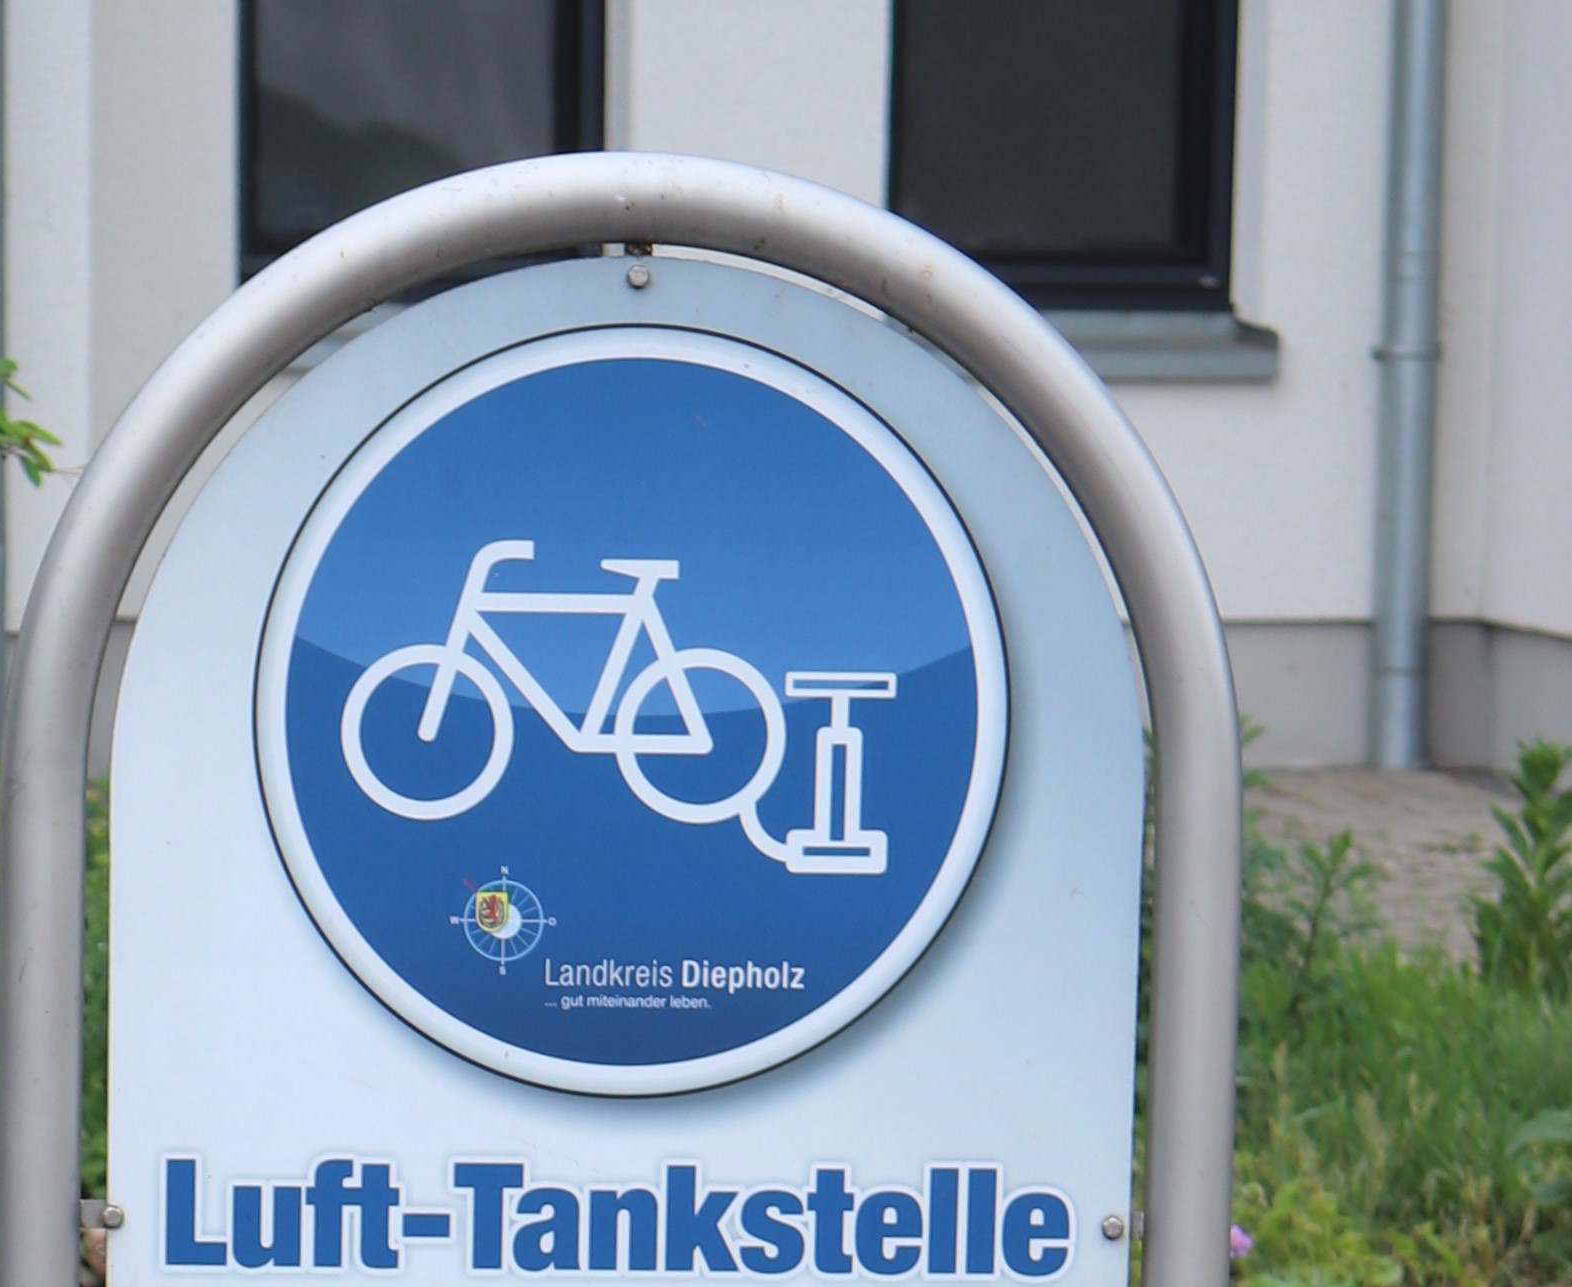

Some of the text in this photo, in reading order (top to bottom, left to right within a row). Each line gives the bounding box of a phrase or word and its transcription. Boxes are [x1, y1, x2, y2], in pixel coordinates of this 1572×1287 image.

[500, 865, 509, 875] N
[499, 965, 507, 975] S
[544, 957, 807, 995] Landkreis Diepholz
[560, 995, 584, 1010] gut
[586, 993, 667, 1009] miteinander
[670, 994, 712, 1010] leben.
[163, 1156, 1073, 1278] Luft-Tankstelle
